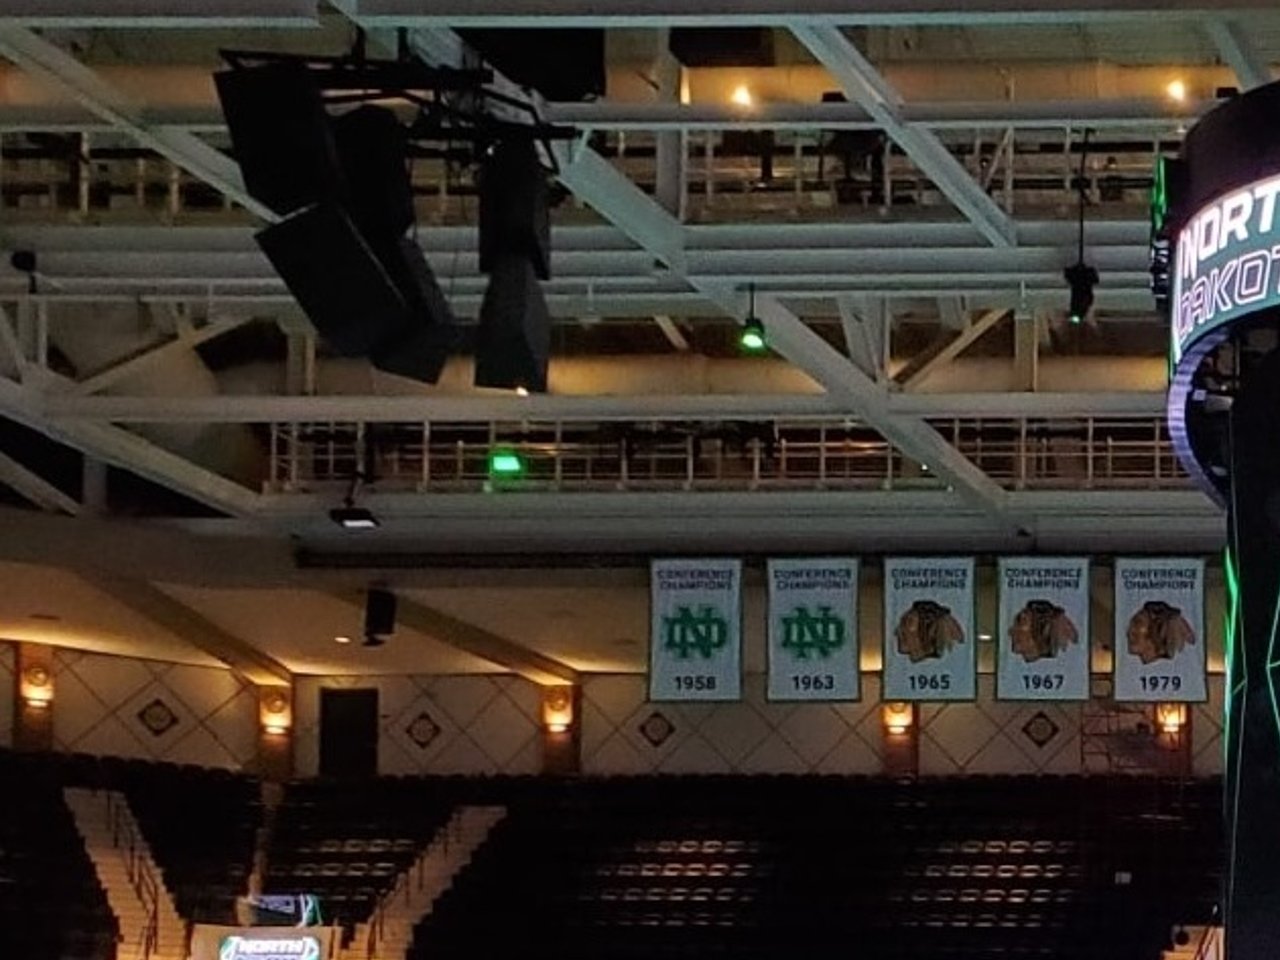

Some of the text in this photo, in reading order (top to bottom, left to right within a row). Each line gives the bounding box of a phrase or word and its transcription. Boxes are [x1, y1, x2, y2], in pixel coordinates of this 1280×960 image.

[657, 569, 734, 579] CONFERENCE
[774, 568, 852, 580] CONFERENCE
[890, 568, 968, 578] CONFERENCE
[1005, 567, 1083, 578] CONFERENCE
[1121, 568, 1198, 579] CONFERENCE
[659, 580, 732, 591] CHAMPIONS
[776, 580, 850, 591] CHAMPIONS
[893, 579, 966, 589] CHAMPIONS
[1008, 578, 1080, 590] CHAMPIONS
[1124, 580, 1196, 590] CHAMPIONS
[675, 675, 716, 691] 1958
[792, 675, 834, 691] 1963
[909, 674, 950, 690] 1965
[1022, 674, 1064, 690] 1967
[1139, 675, 1181, 691] 1979
